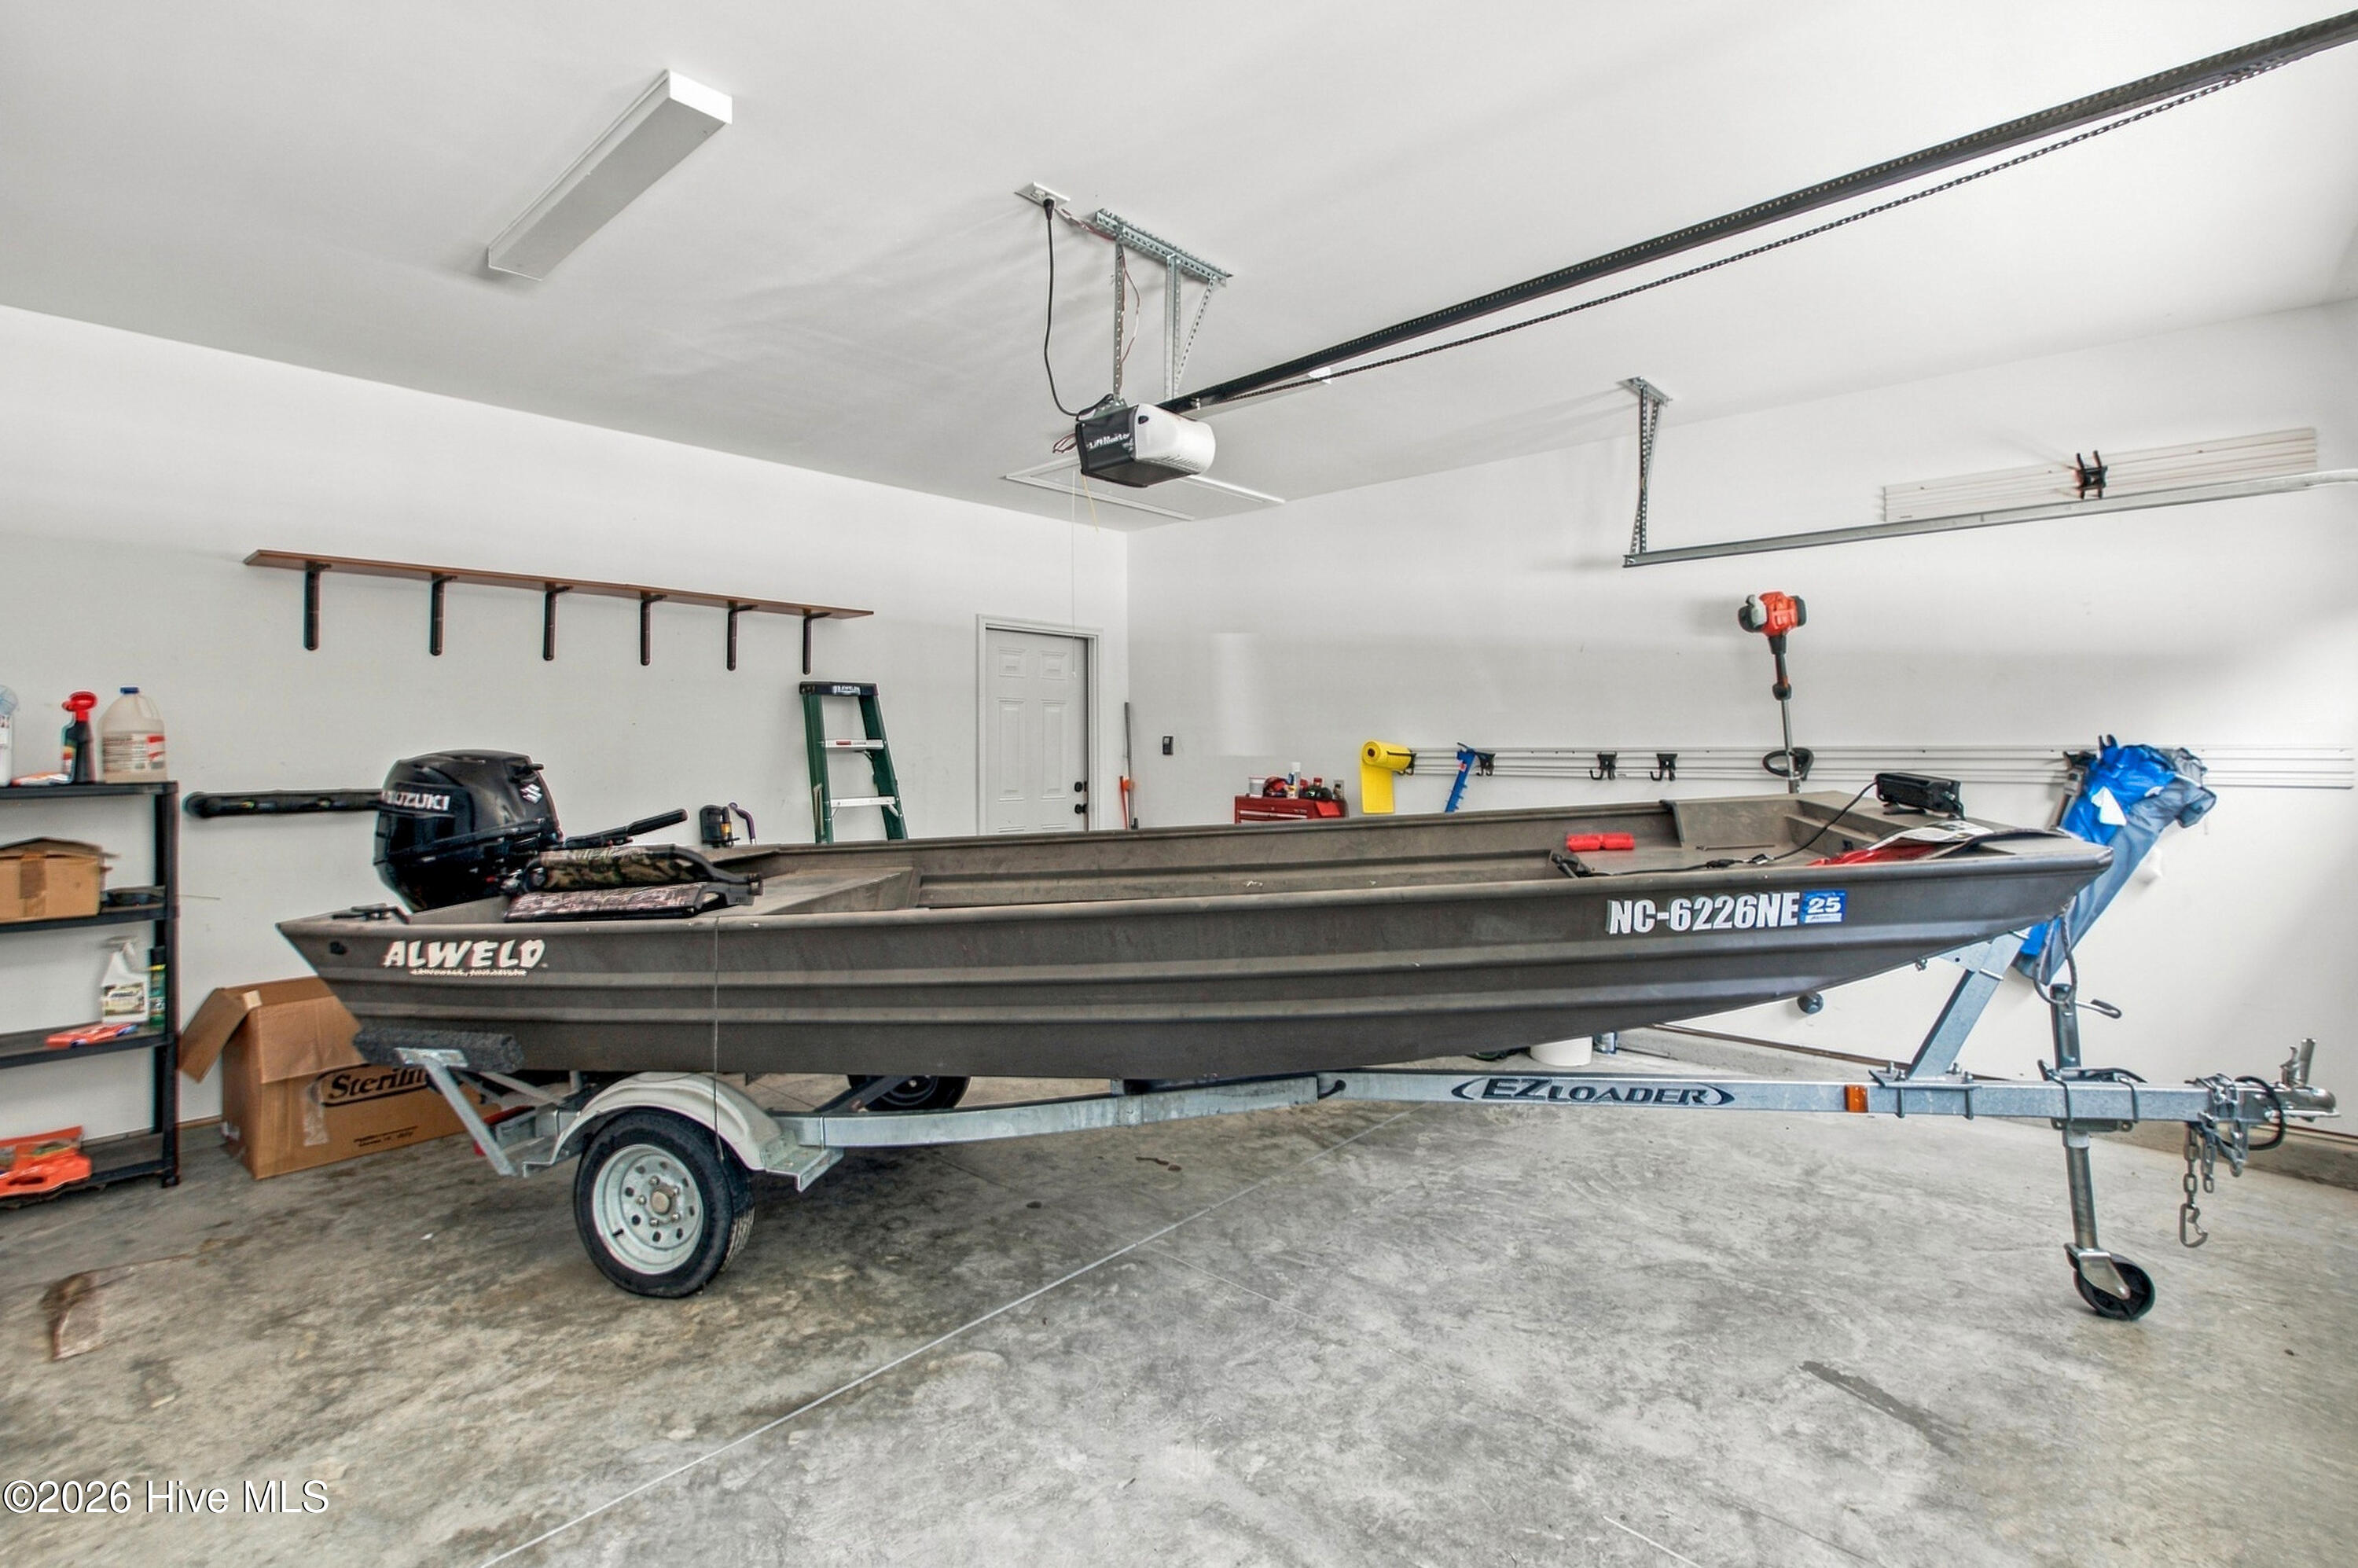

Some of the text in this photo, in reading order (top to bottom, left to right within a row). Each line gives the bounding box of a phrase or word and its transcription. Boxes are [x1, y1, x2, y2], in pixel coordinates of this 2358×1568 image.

[1608, 892, 1800, 934] NC-6226NE
[1807, 897, 1842, 913] 25
[382, 939, 544, 968] ALWELD
